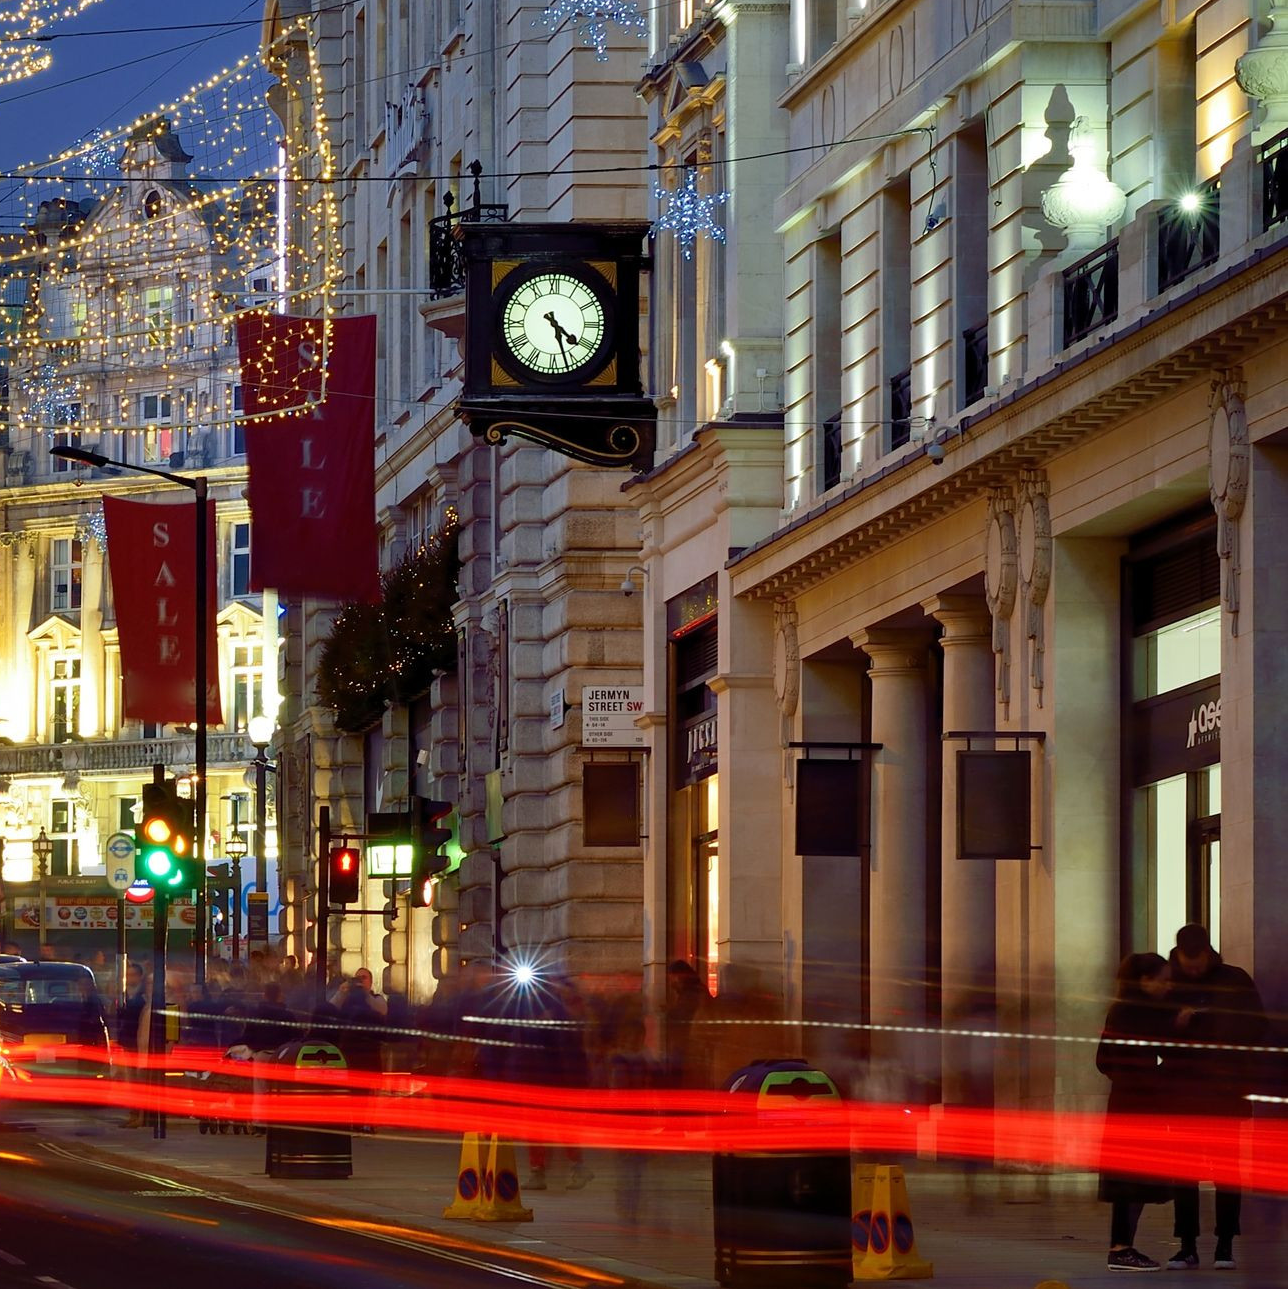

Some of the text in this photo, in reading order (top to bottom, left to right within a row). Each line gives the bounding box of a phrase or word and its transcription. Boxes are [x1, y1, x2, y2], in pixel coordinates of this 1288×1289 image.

[297, 341, 327, 519] SALE
[153, 522, 181, 666] SALE
[588, 690, 630, 701] JERMYN
[588, 702, 624, 712] STREET
